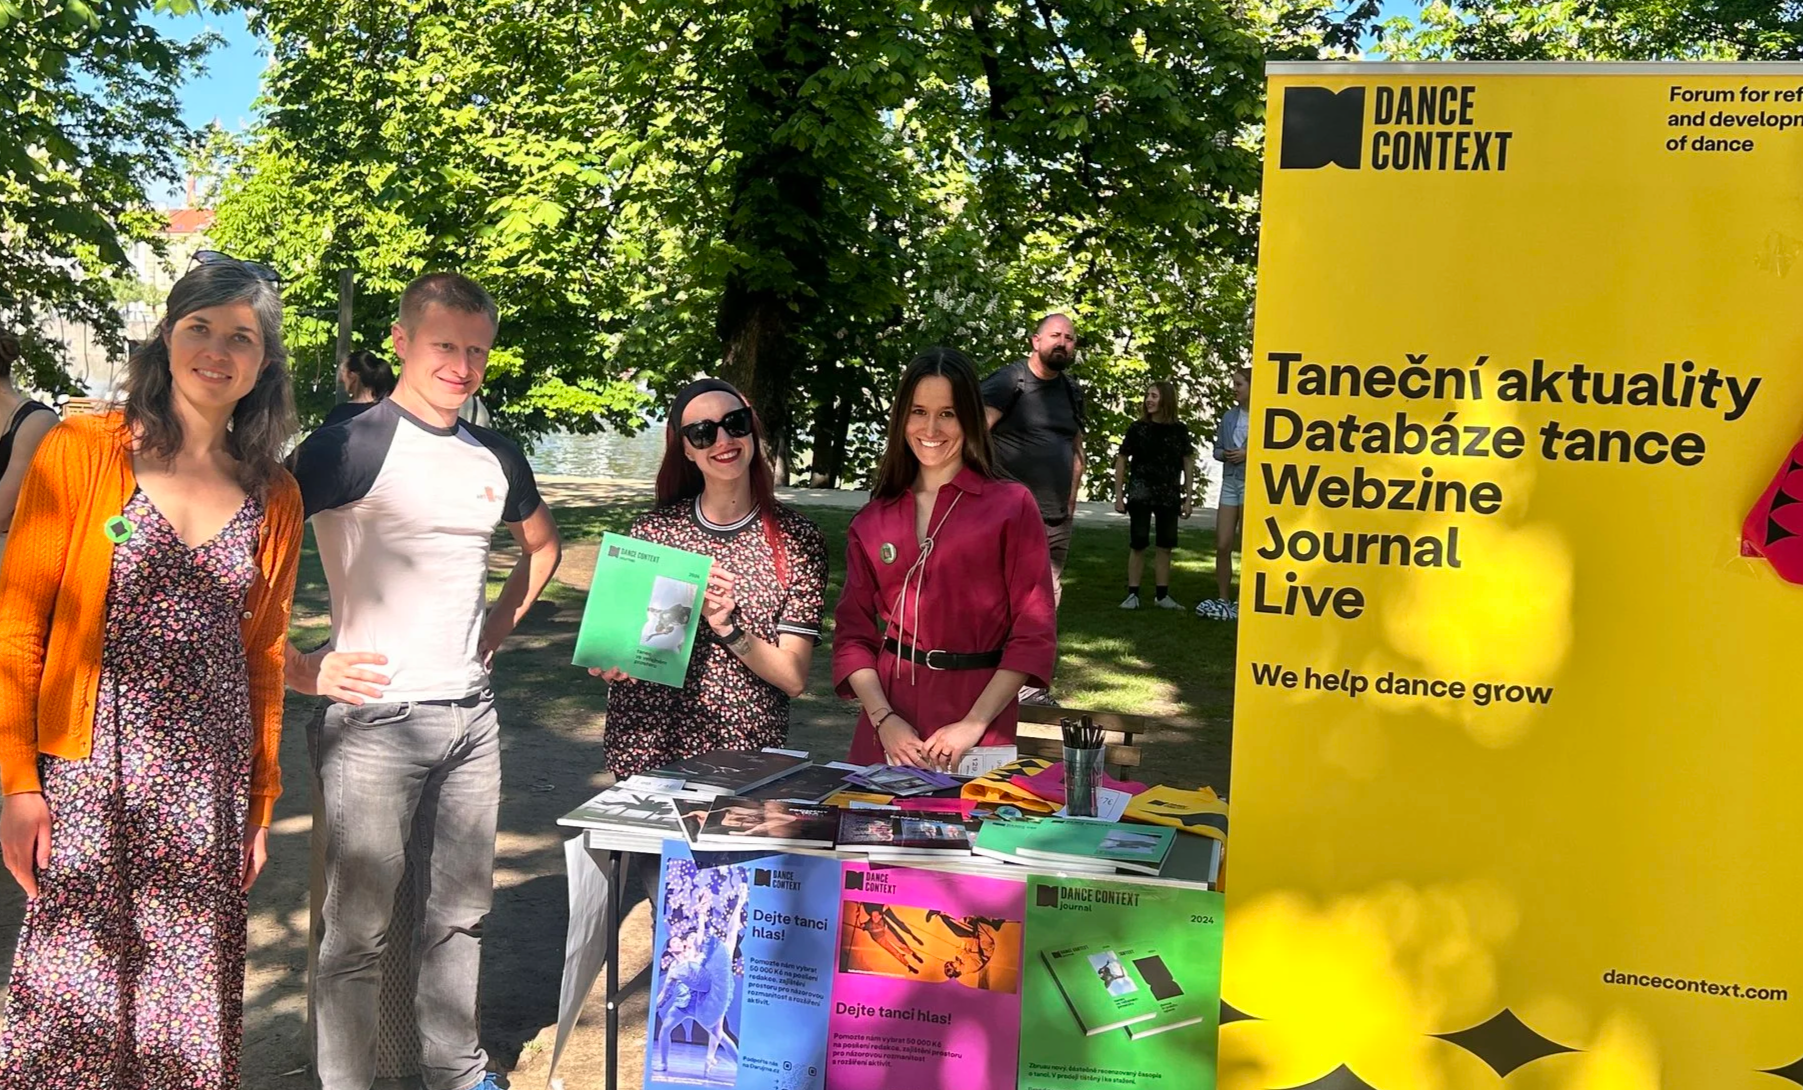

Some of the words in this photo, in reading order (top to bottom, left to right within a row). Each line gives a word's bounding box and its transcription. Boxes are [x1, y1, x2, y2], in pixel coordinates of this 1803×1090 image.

[1670, 86, 1734, 102] Forum
[1740, 86, 1770, 102] for
[1774, 86, 1803, 102] ref
[1374, 86, 1476, 125] DANCE
[1668, 111, 1706, 126] and
[1372, 130, 1512, 171] CONTEXT
[1666, 135, 1688, 151] of
[1691, 136, 1754, 152] dance
[1268, 352, 1489, 400] Taneční
[1496, 360, 1762, 421] aktuality
[1263, 408, 1524, 459] Databáze
[1540, 420, 1706, 466] tance
[1261, 463, 1502, 514] Webzine
[1256, 516, 1461, 568] Journal
[1254, 572, 1364, 620] Live
[1252, 662, 1298, 688] We
[1304, 666, 1368, 696] help
[1376, 672, 1466, 698] dance
[1472, 682, 1554, 706] grow
[773, 870, 794, 880] DANCE
[866, 872, 888, 883] DANCE
[772, 880, 801, 890] CONTEXT
[865, 882, 896, 894] CONTEXT
[1060, 886, 1092, 902] DANCE
[1095, 890, 1140, 906] CONTEXT
[1059, 902, 1092, 912] journal
[753, 909, 791, 925] Dejte
[794, 915, 828, 930] tanci
[1190, 915, 1214, 924] 2024
[752, 926, 785, 940] hlas!
[750, 957, 779, 967] Pomozte
[796, 964, 817, 973] vybrat
[748, 982, 777, 990] prostoru
[1603, 970, 1788, 1000] dancecontext.com
[836, 1002, 875, 1018] Dejte
[879, 1006, 915, 1020] tanci
[917, 1010, 952, 1025] hlas!
[834, 1033, 864, 1041] Pomozte
[882, 1035, 905, 1044] vybrat
[846, 1050, 882, 1059] názorovou
[932, 1049, 962, 1059] prostoru
